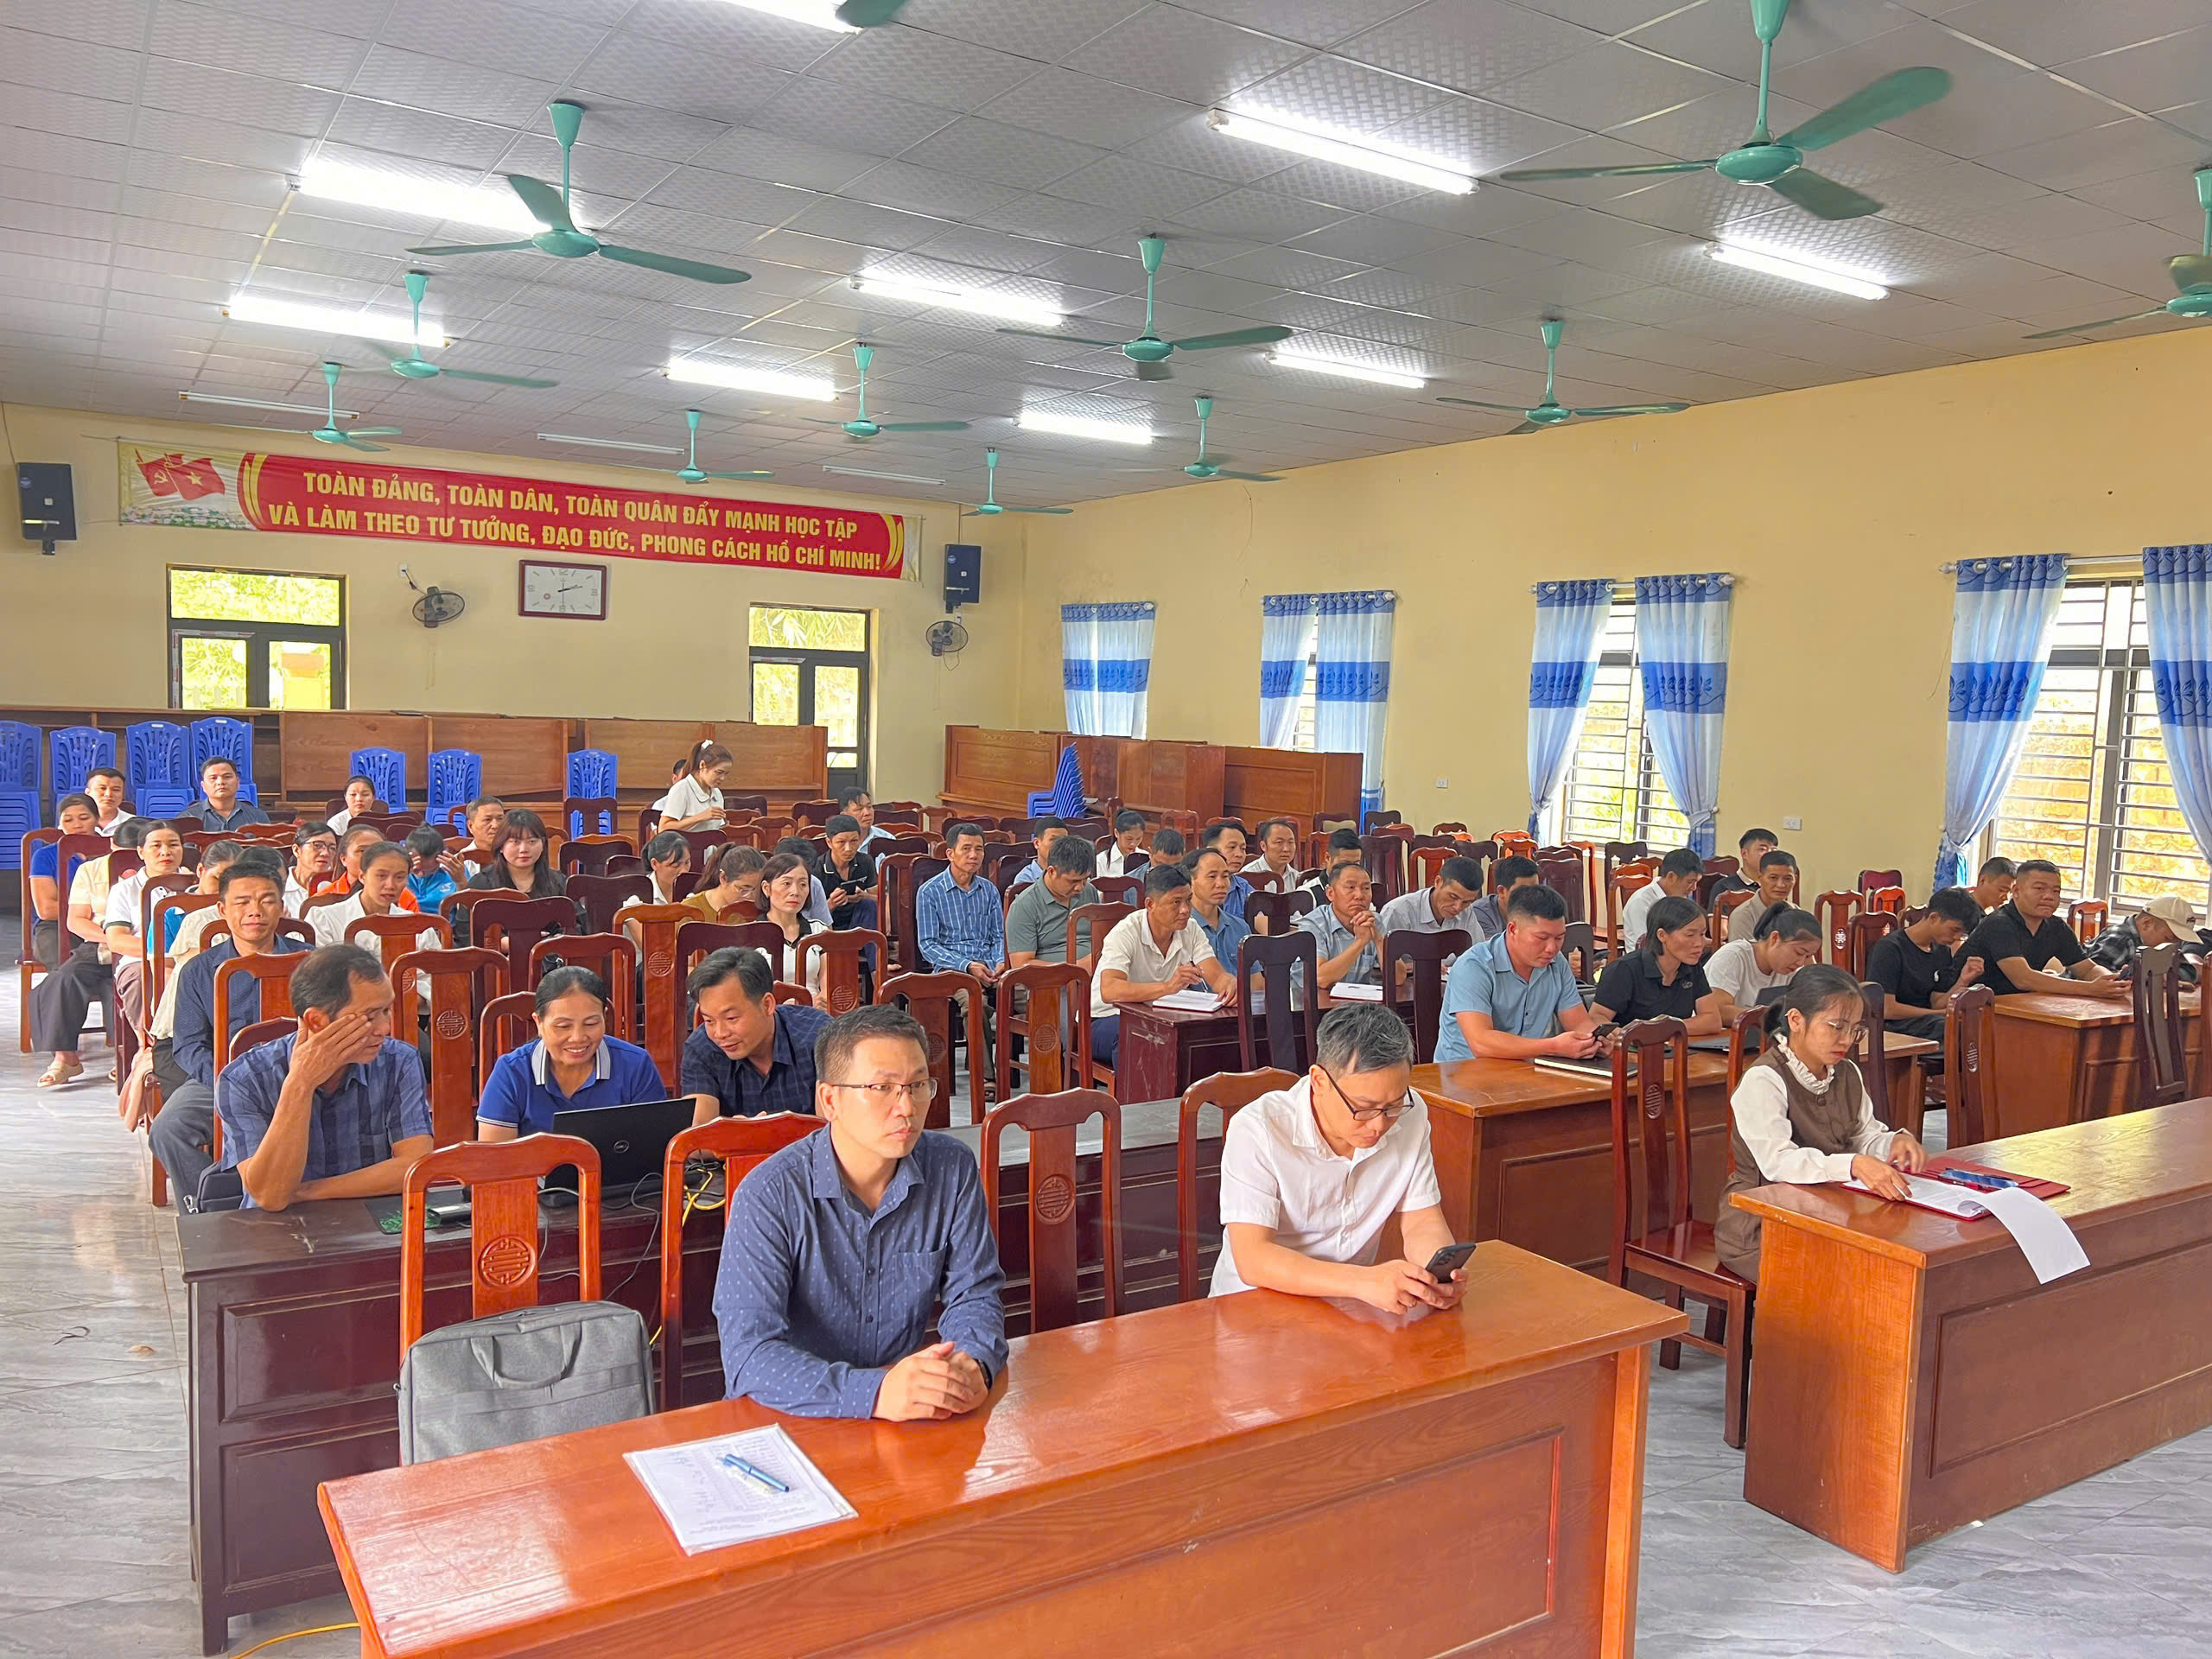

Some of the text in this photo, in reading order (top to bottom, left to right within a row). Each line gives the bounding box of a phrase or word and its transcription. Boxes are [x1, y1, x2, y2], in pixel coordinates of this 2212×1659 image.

[268, 501, 880, 571] VÀ LÀM THEO TƯ TƯỞNG, ĐẠO ĐỨC, PHONG CÁCH HỒ CHÍ MINH!
[303, 470, 858, 542] TOÀN ĐẢNG, TOÀN DÂN, TOÀN QUÂN ĐẨY MẠNH HỌC TẬP
